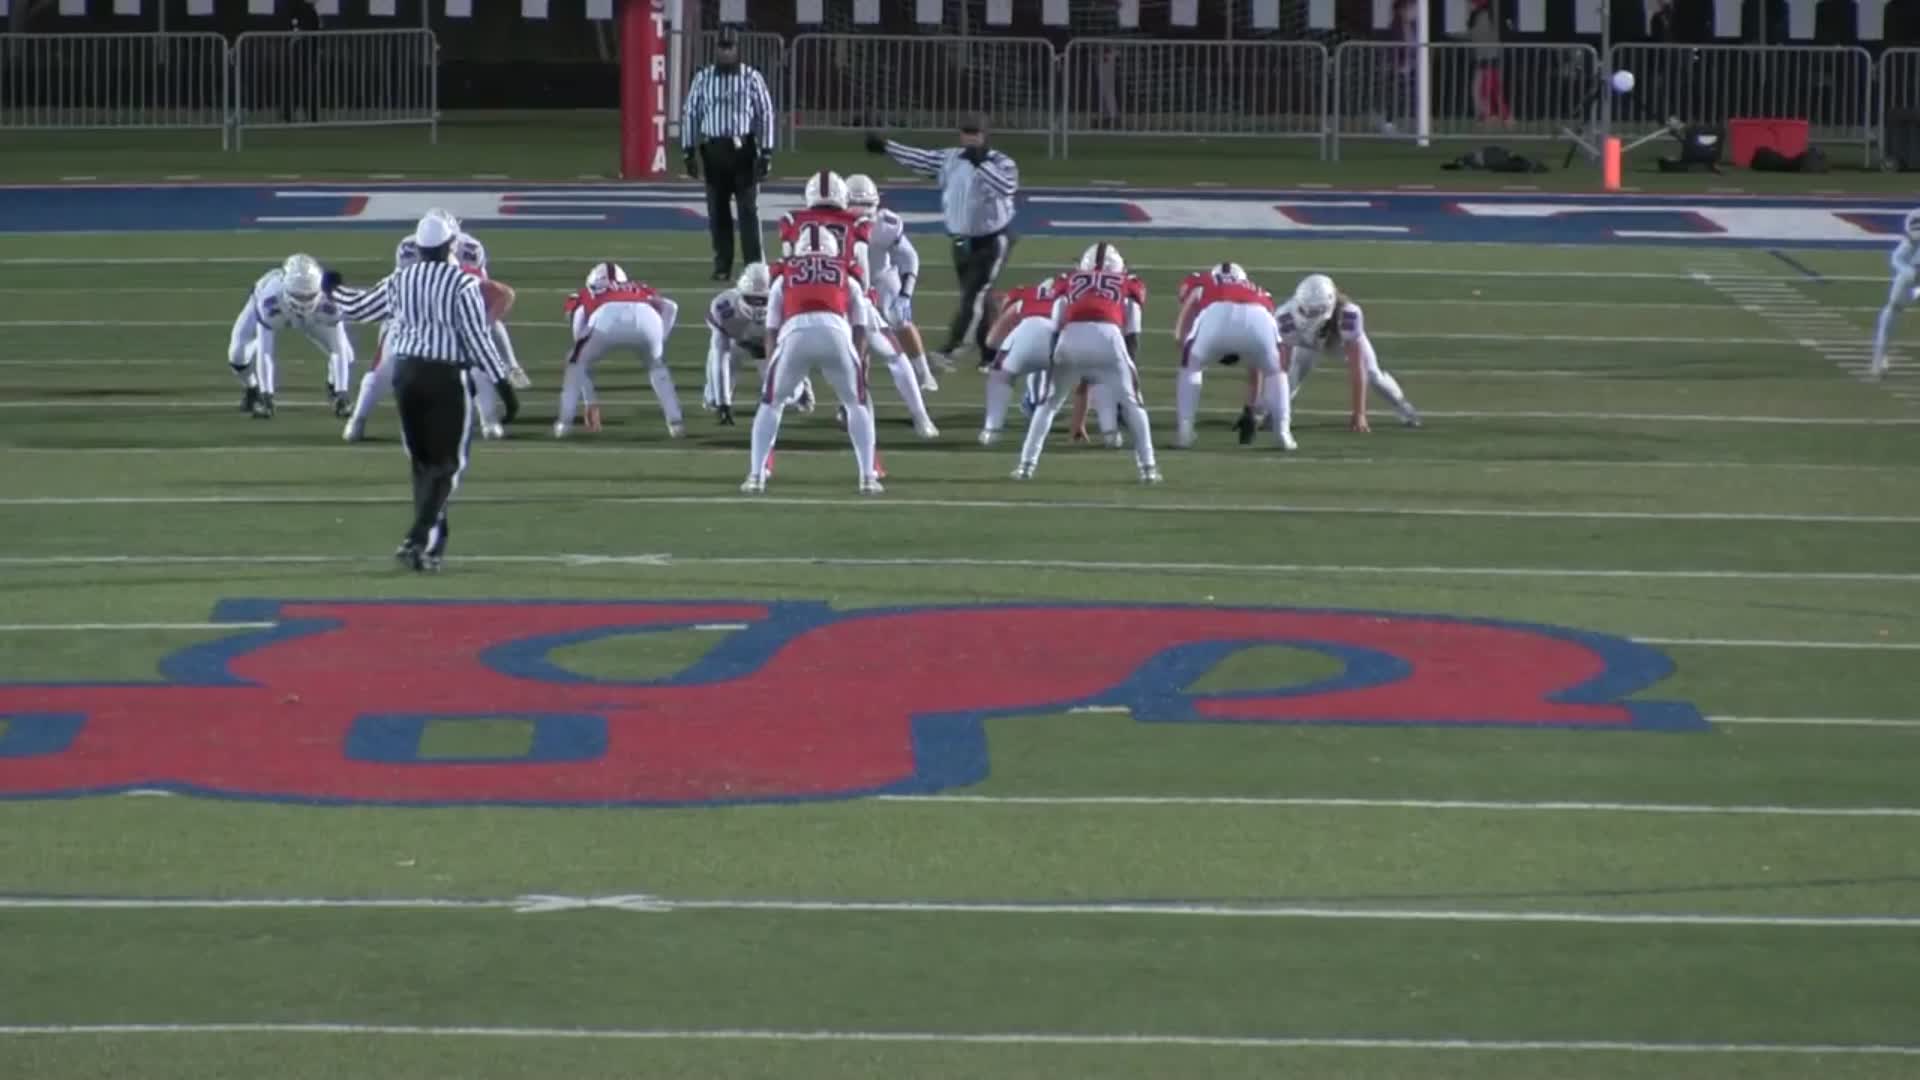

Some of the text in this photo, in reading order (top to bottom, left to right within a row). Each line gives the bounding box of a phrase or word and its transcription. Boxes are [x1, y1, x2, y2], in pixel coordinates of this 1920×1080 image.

[651, 54, 667, 173] RITA
[788, 256, 844, 286] 35
[1070, 272, 1123, 303] 25
